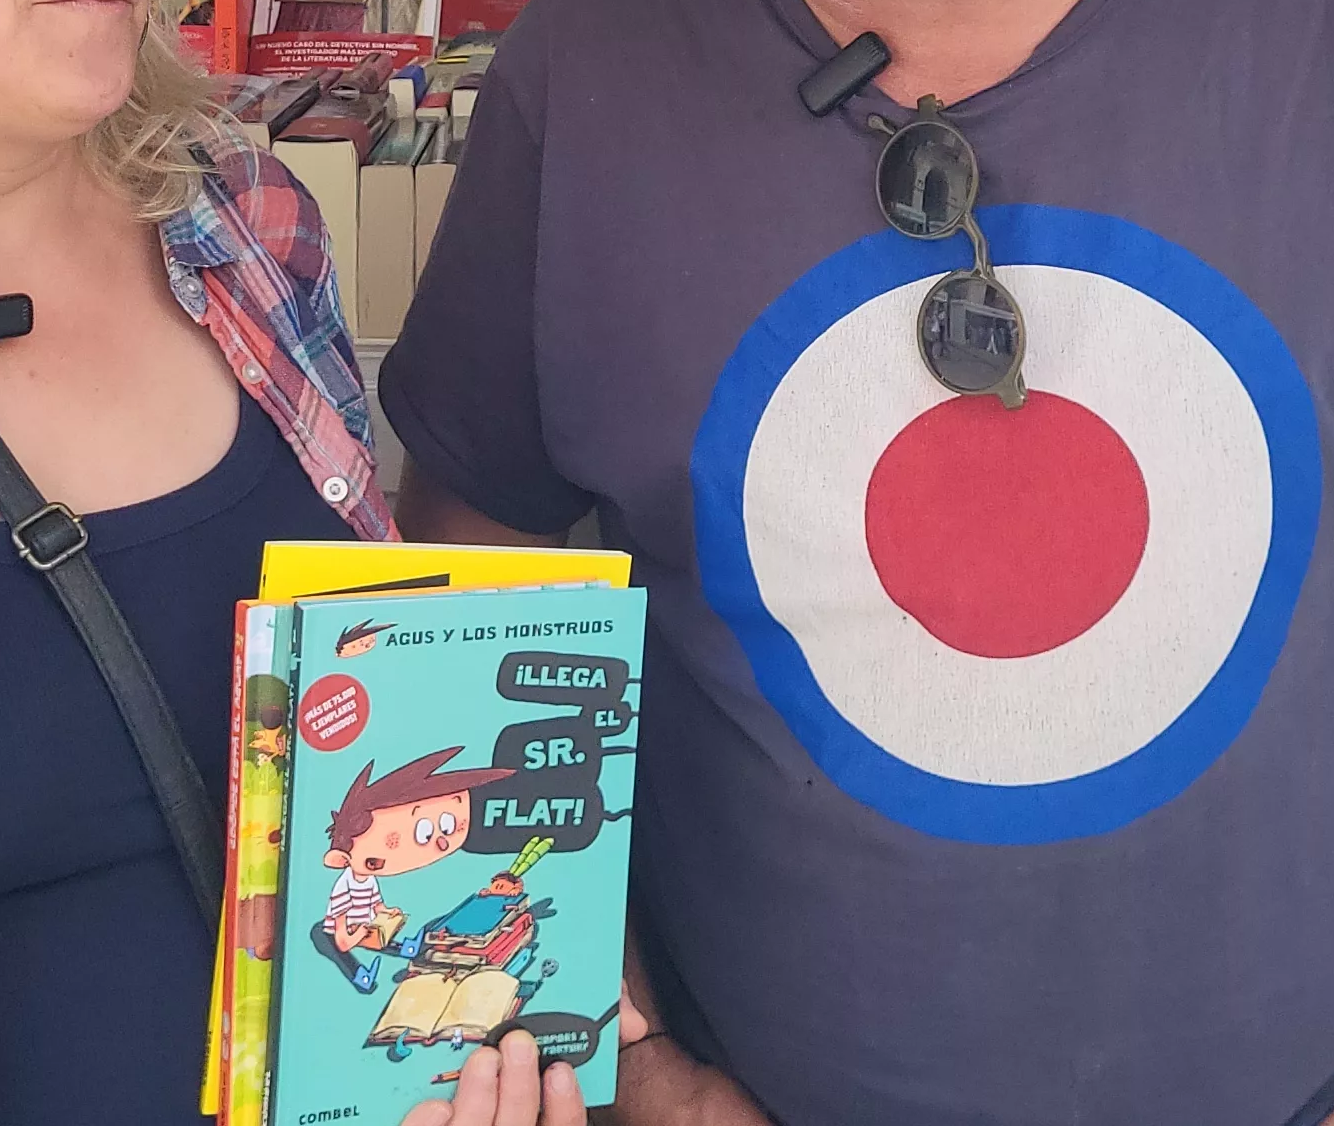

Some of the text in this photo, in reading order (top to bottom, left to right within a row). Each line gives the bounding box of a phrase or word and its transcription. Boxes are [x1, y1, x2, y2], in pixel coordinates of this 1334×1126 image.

[386, 620, 614, 647] AGUS Y LOS MONSTRUOS
[515, 665, 607, 689] ¡LLEGA
[311, 700, 357, 732] EJEMPLARES
[595, 710, 620, 727] EL
[524, 738, 586, 770] SR.
[483, 799, 585, 827] FLAT!
